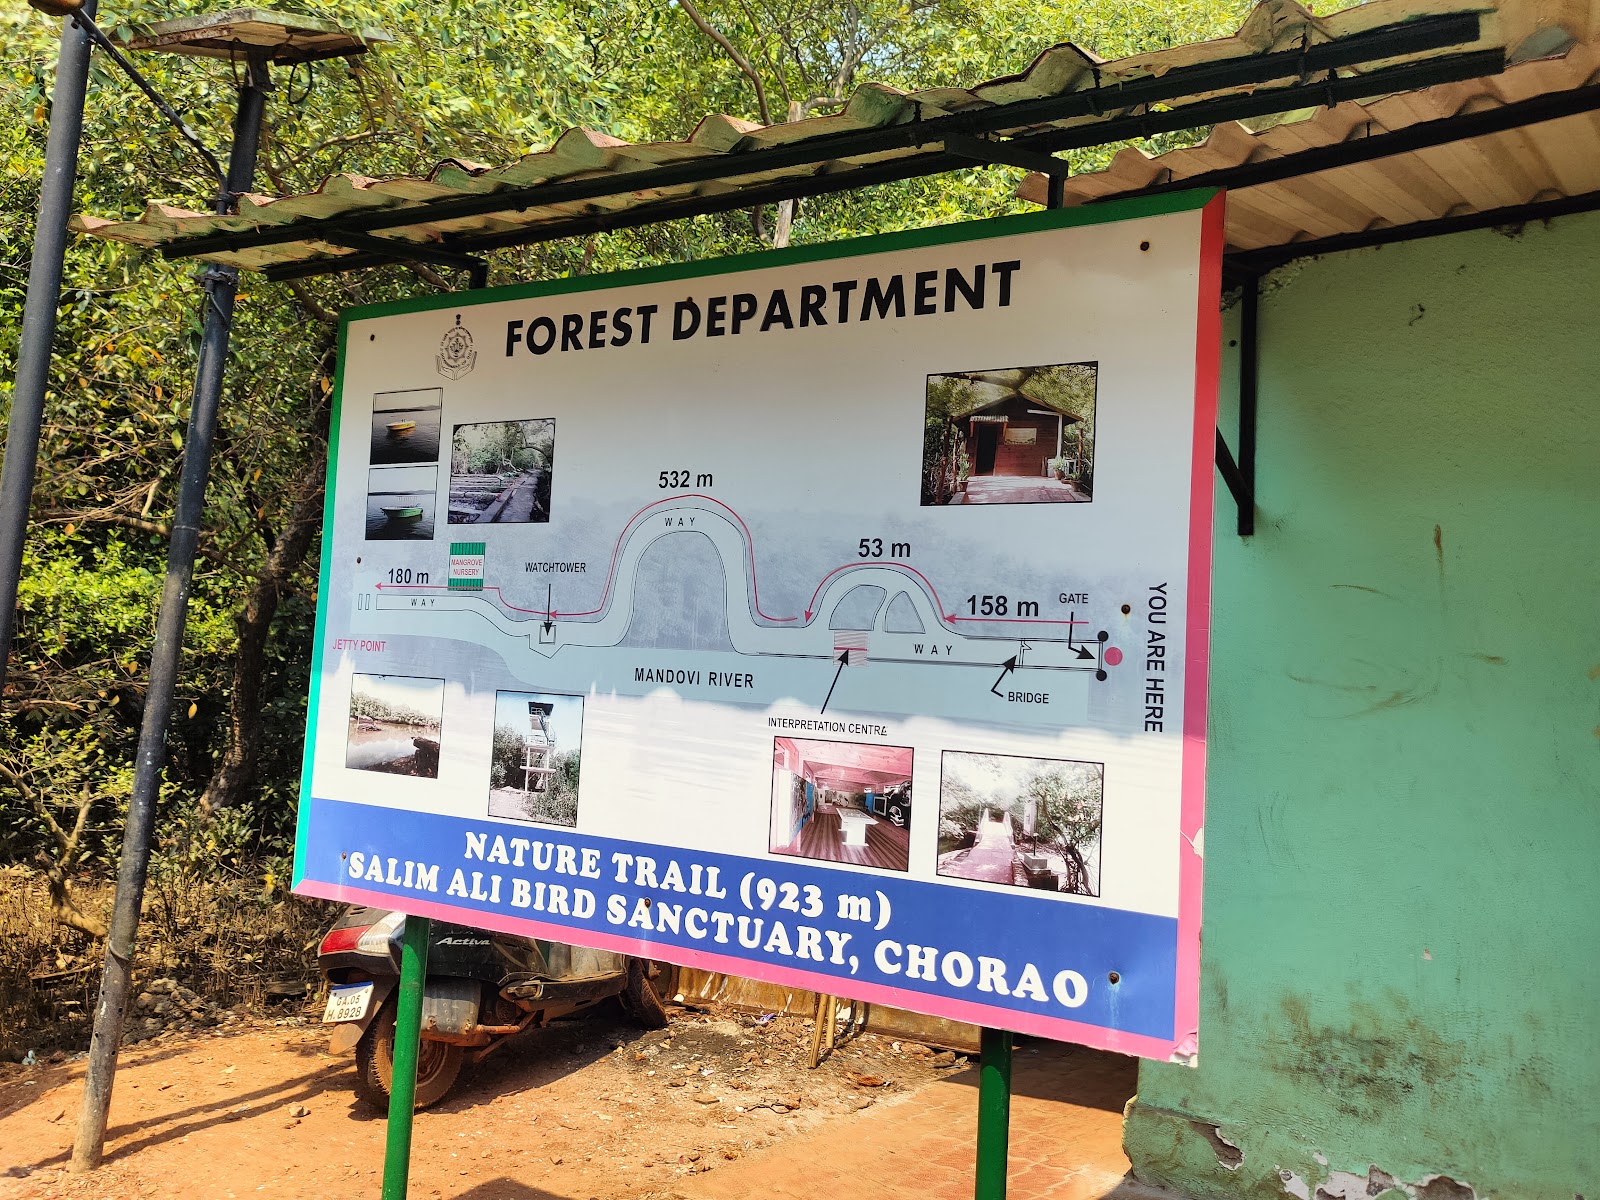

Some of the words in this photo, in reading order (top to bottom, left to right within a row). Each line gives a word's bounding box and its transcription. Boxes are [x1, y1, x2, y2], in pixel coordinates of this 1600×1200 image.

[506, 304, 658, 357] FOREST
[672, 260, 1021, 341] DEPARTMENT
[658, 470, 690, 489] 532
[696, 473, 713, 488] m
[664, 517, 695, 527] WAY
[858, 538, 884, 558] 53
[891, 542, 911, 558] m
[453, 568, 479, 576] NURSERY
[525, 562, 586, 573] WATCHTOWER
[388, 568, 412, 584] 180
[416, 571, 429, 585] m
[410, 598, 435, 607] WAY
[966, 595, 1008, 616] 158
[1017, 600, 1039, 617] m
[1059, 593, 1089, 605] GATE
[1148, 581, 1168, 624] YOU
[332, 639, 358, 650] JETTY
[360, 640, 386, 652] POINT
[914, 644, 952, 656] WAY
[1146, 629, 1166, 672] ARE
[634, 667, 700, 686] MANDOVI
[708, 671, 754, 688] RIVER
[1008, 691, 1049, 704] BRIDGE
[1144, 678, 1165, 733] HERE
[768, 717, 846, 733] INTERPRETATION
[464, 831, 601, 879] NATURE
[611, 852, 727, 899] TRAIL
[739, 871, 824, 918] (923
[837, 890, 892, 931] m)
[348, 851, 440, 892] SALIM
[446, 868, 501, 903] ALI
[510, 878, 596, 919] BIRD
[606, 894, 859, 975] SANCTUARY,
[873, 940, 1089, 1009] CHORAO
[436, 937, 490, 945] Activa
